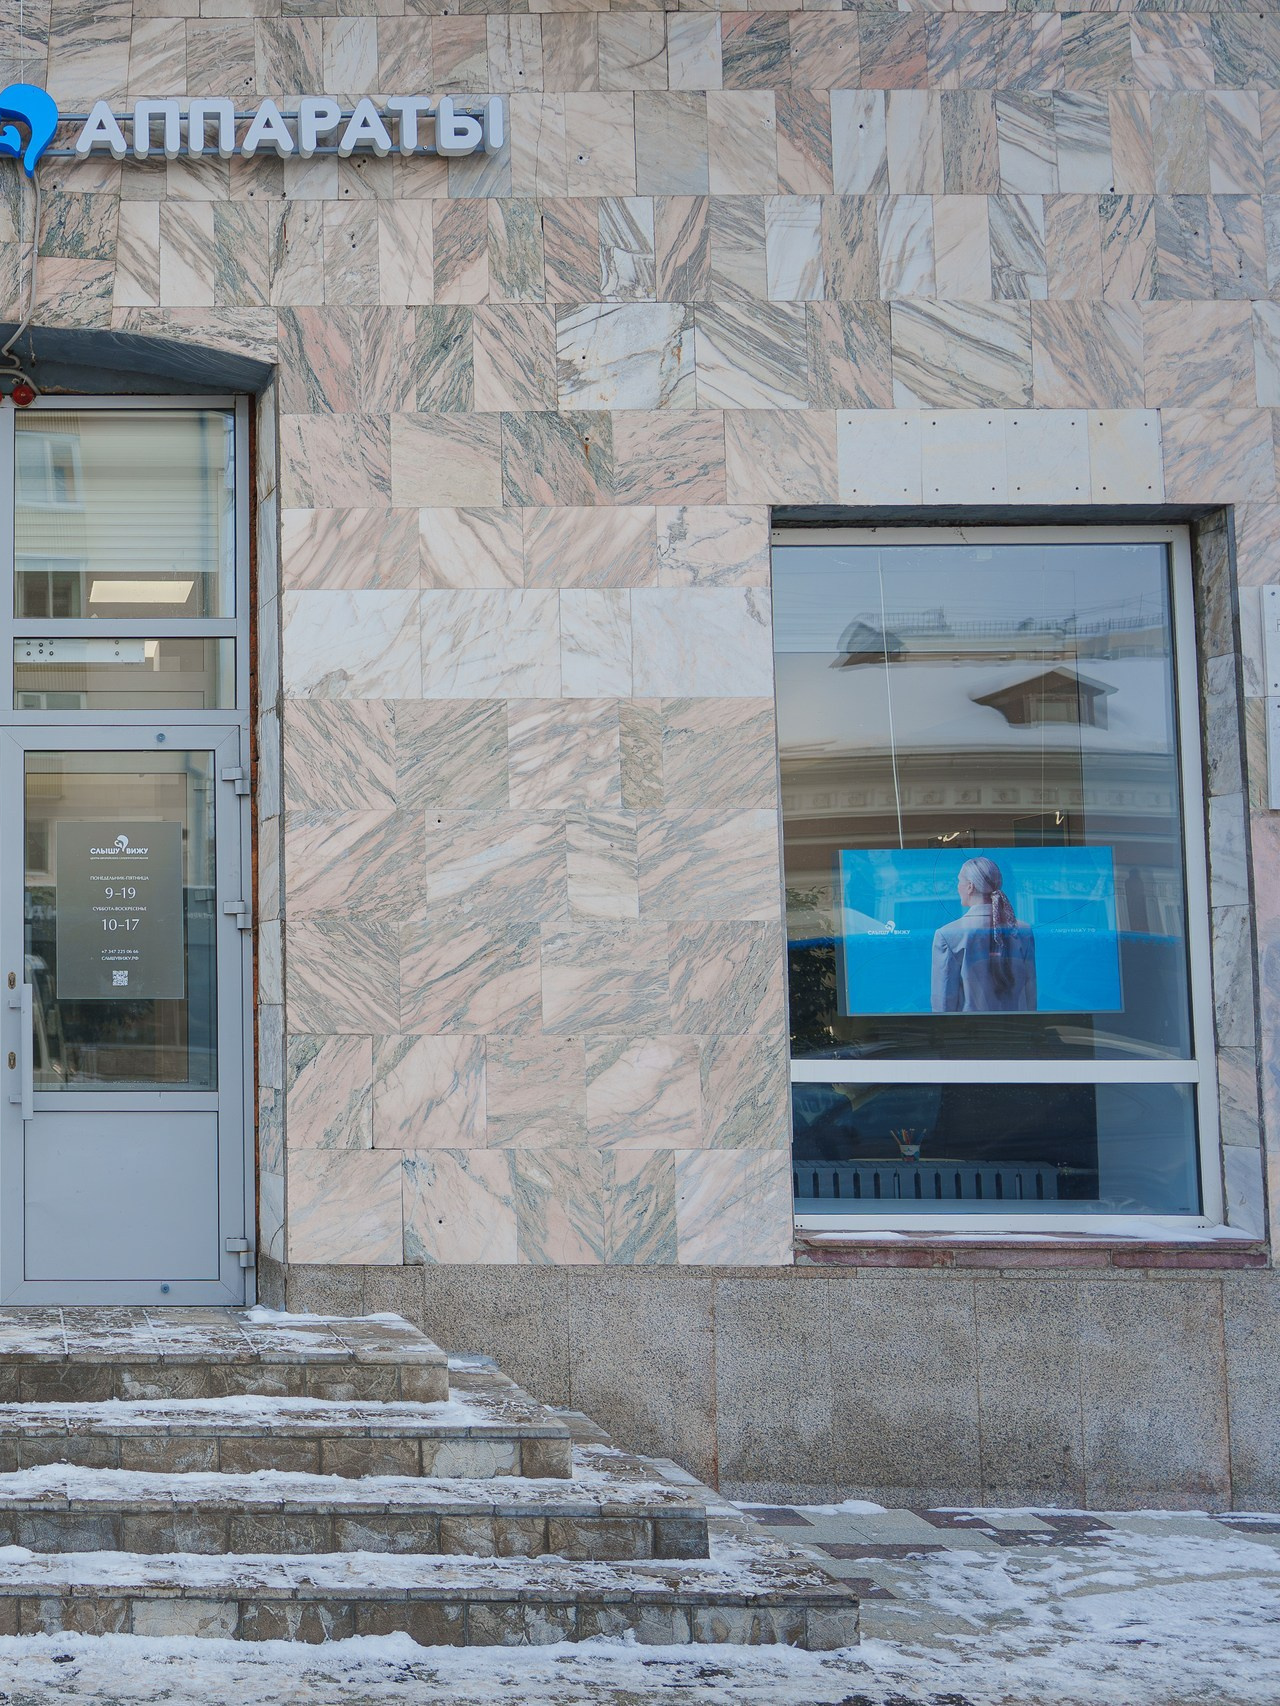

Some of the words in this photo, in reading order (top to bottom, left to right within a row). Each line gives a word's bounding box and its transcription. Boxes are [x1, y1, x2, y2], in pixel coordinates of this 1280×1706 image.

[75, 96, 505, 159] АППАРАТЫ
[90, 847, 120, 855] СЛЫШУ
[126, 847, 149, 855] ВИЖУ
